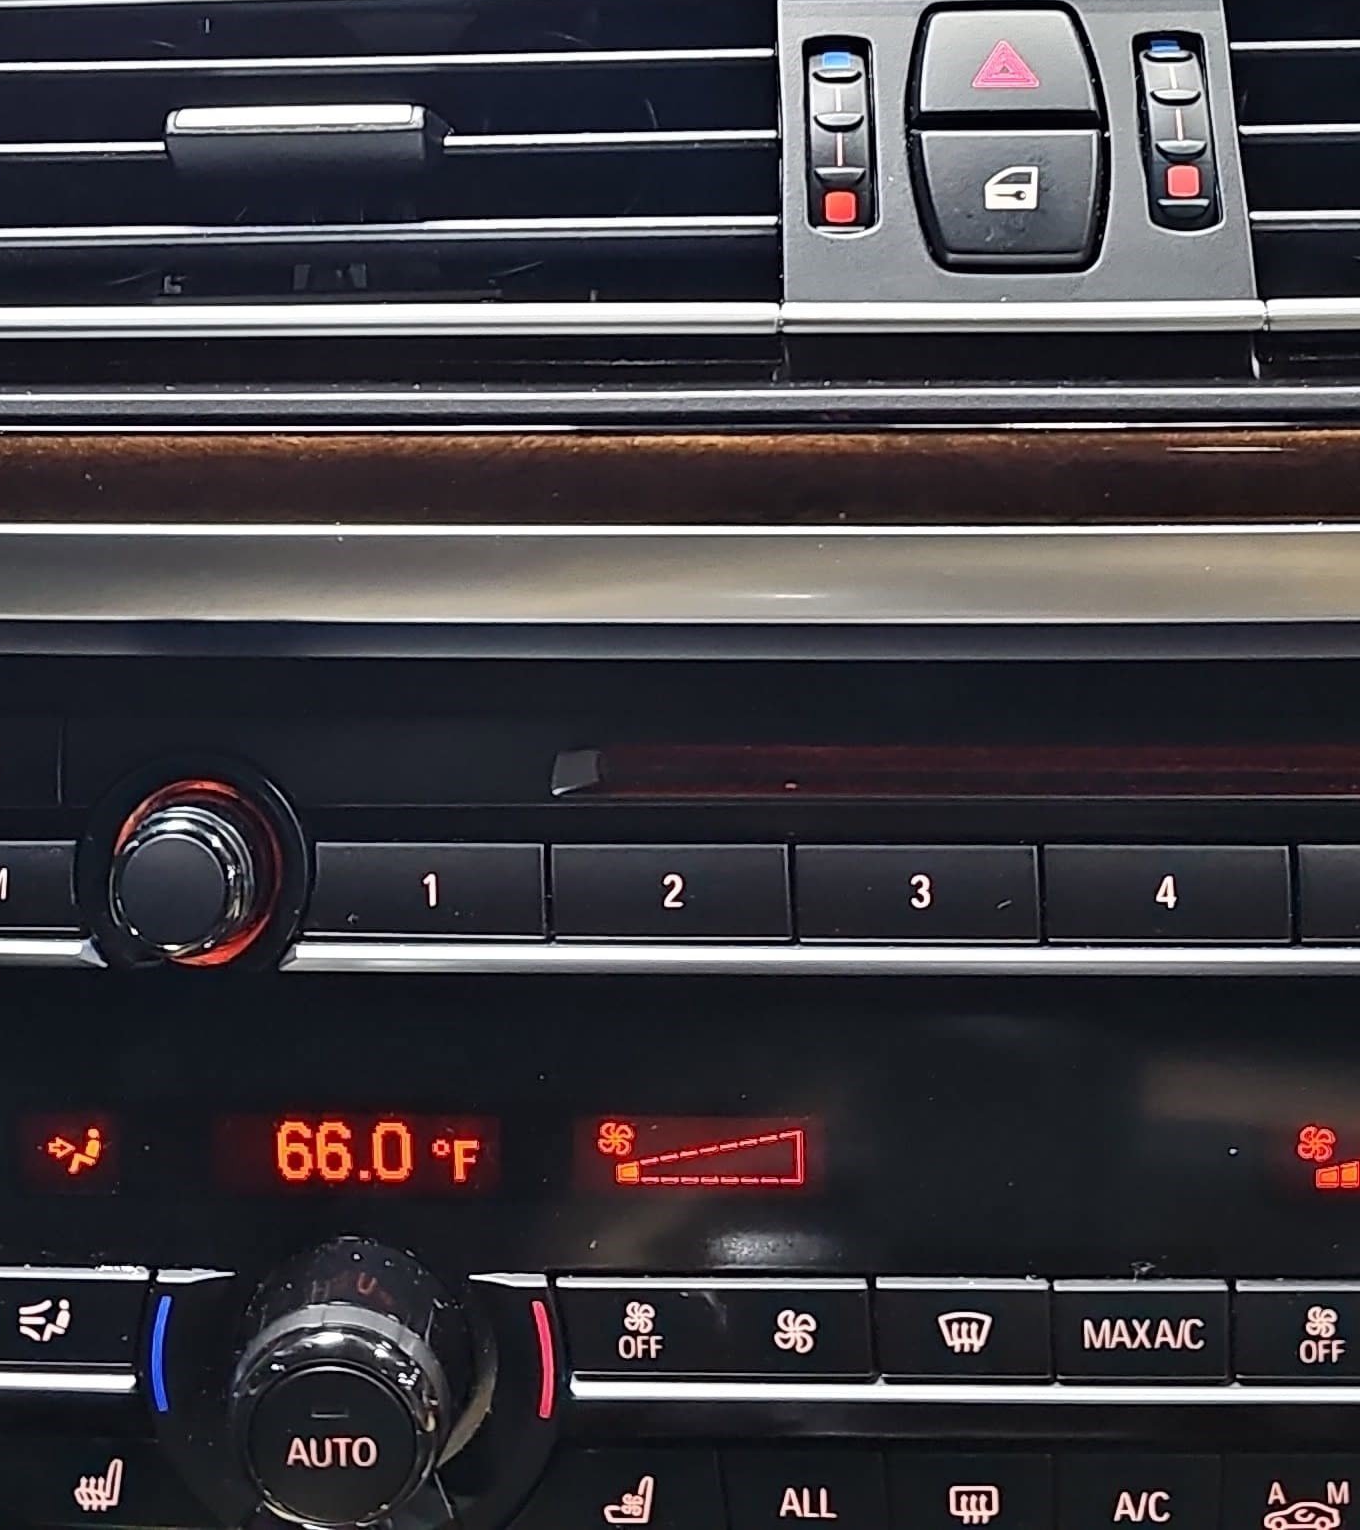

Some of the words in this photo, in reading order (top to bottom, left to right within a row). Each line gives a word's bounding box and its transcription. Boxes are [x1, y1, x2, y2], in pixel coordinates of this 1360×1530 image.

[422, 872, 438, 907] 1
[662, 873, 685, 908] 2
[909, 874, 932, 909] 3
[1154, 874, 1177, 909] 4
[277, 1121, 414, 1181] 66.0
[617, 1335, 664, 1360] OFF
[1299, 1339, 1347, 1364] OFF
[285, 1436, 378, 1468] AUTO
[778, 1486, 838, 1520] ALL
[1113, 1491, 1171, 1523] A/C
[1267, 1481, 1287, 1505] A
[1326, 1481, 1350, 1505] M
